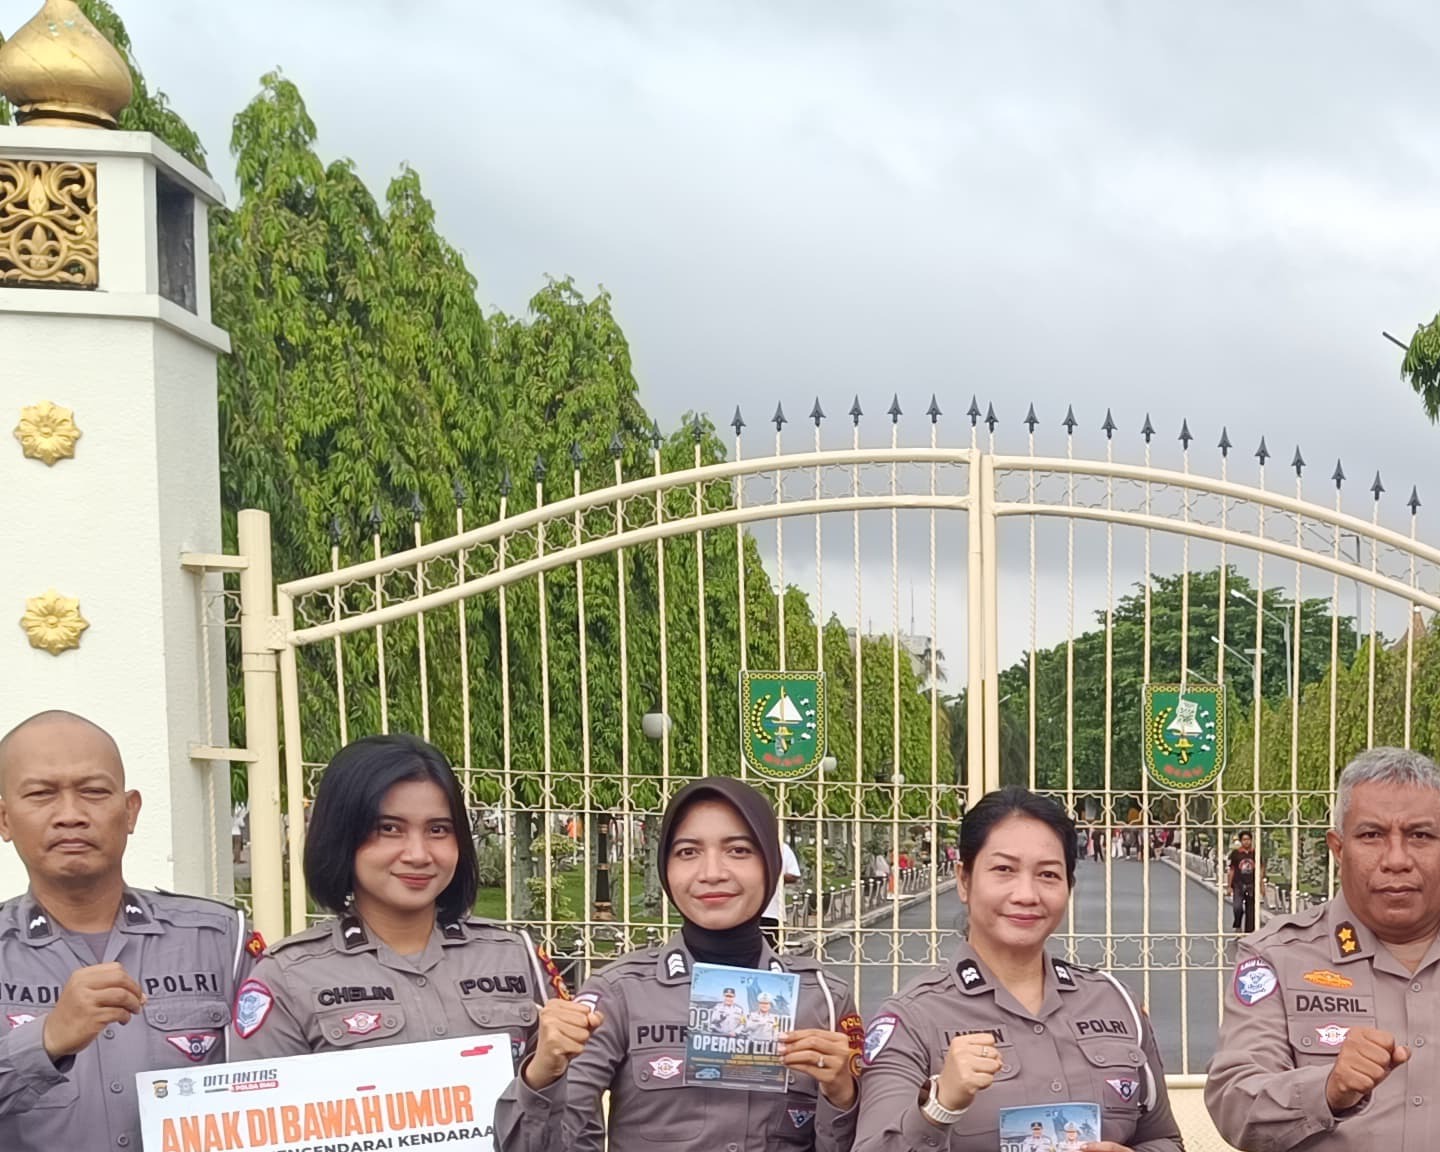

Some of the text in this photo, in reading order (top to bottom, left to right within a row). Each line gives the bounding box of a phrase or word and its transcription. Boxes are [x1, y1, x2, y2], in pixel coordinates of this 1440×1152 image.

[145, 973, 219, 995] POLRI
[459, 975, 527, 995] POLRI
[318, 986, 395, 1006] CHELIN
[1295, 995, 1367, 1013] DASRIL
[1076, 1018, 1128, 1035] POLRI
[693, 1034, 751, 1054] OPERASI
[203, 1068, 278, 1087] DITLANTAS
[246, 1106, 277, 1147] DI
[280, 1095, 384, 1144] BAWAH
[385, 1084, 474, 1132] UMUR
